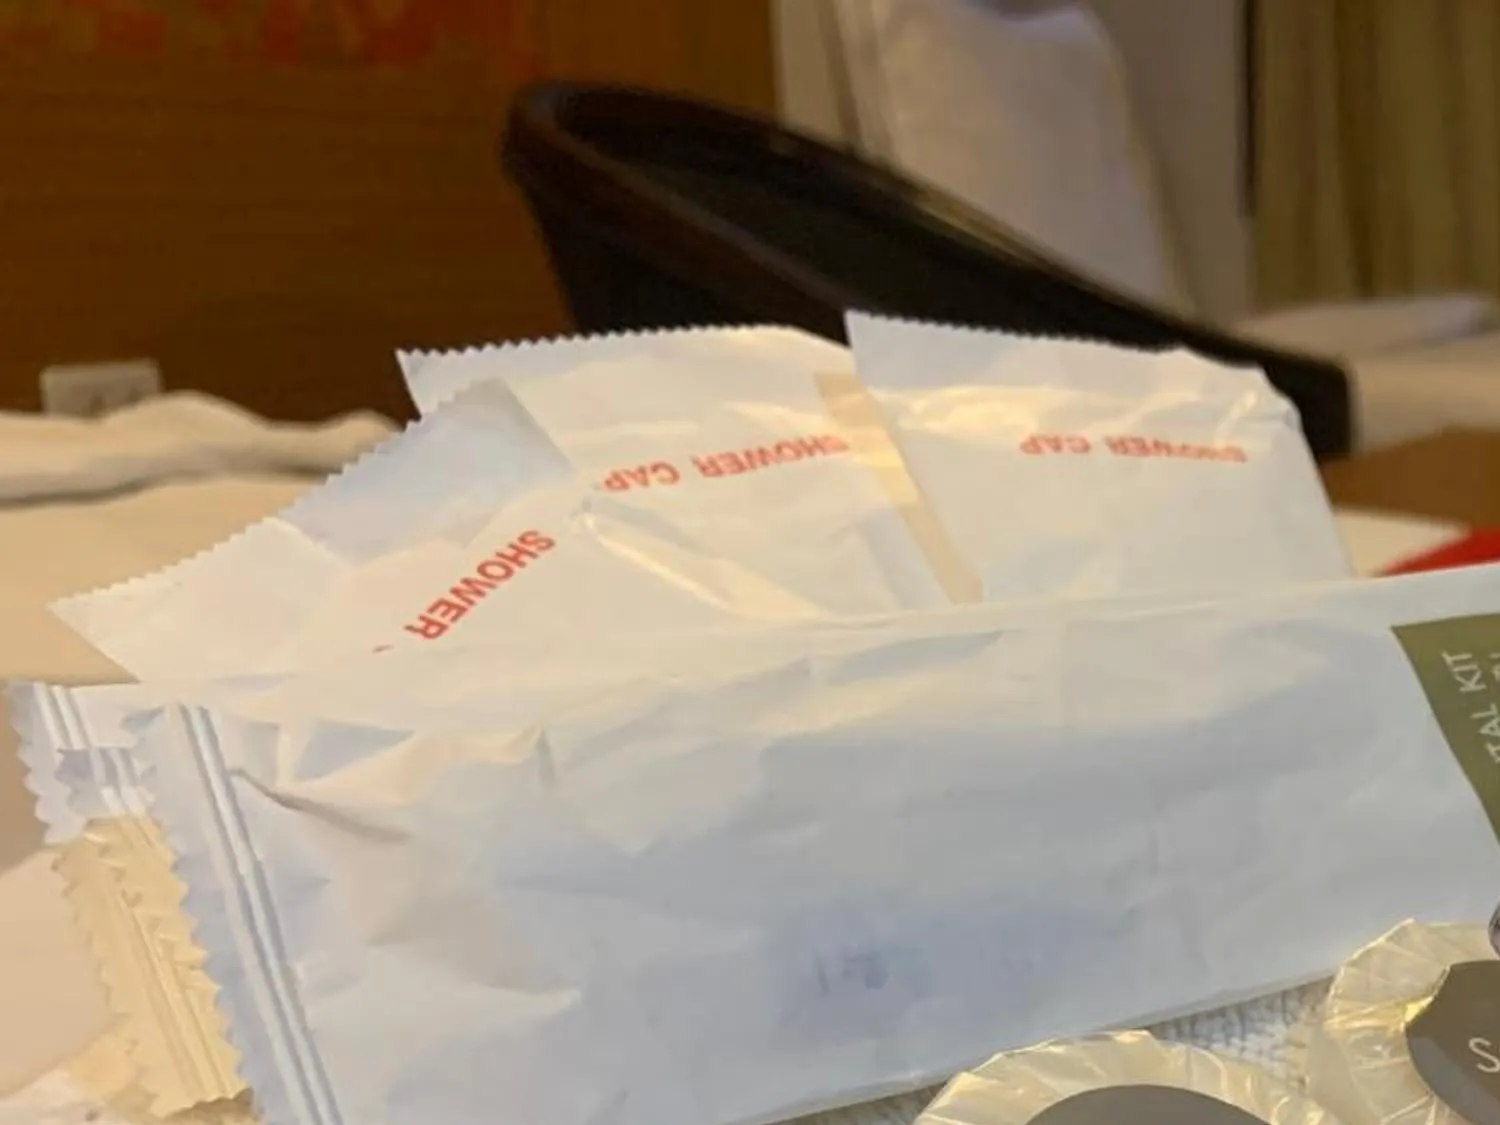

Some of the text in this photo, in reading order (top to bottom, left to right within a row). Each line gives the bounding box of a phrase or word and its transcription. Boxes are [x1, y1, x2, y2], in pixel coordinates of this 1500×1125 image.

[603, 434, 849, 492] SHOWER CAP
[1019, 434, 1092, 454] CAP
[403, 530, 556, 640] SHOWER
[1441, 650, 1487, 693] KIT
